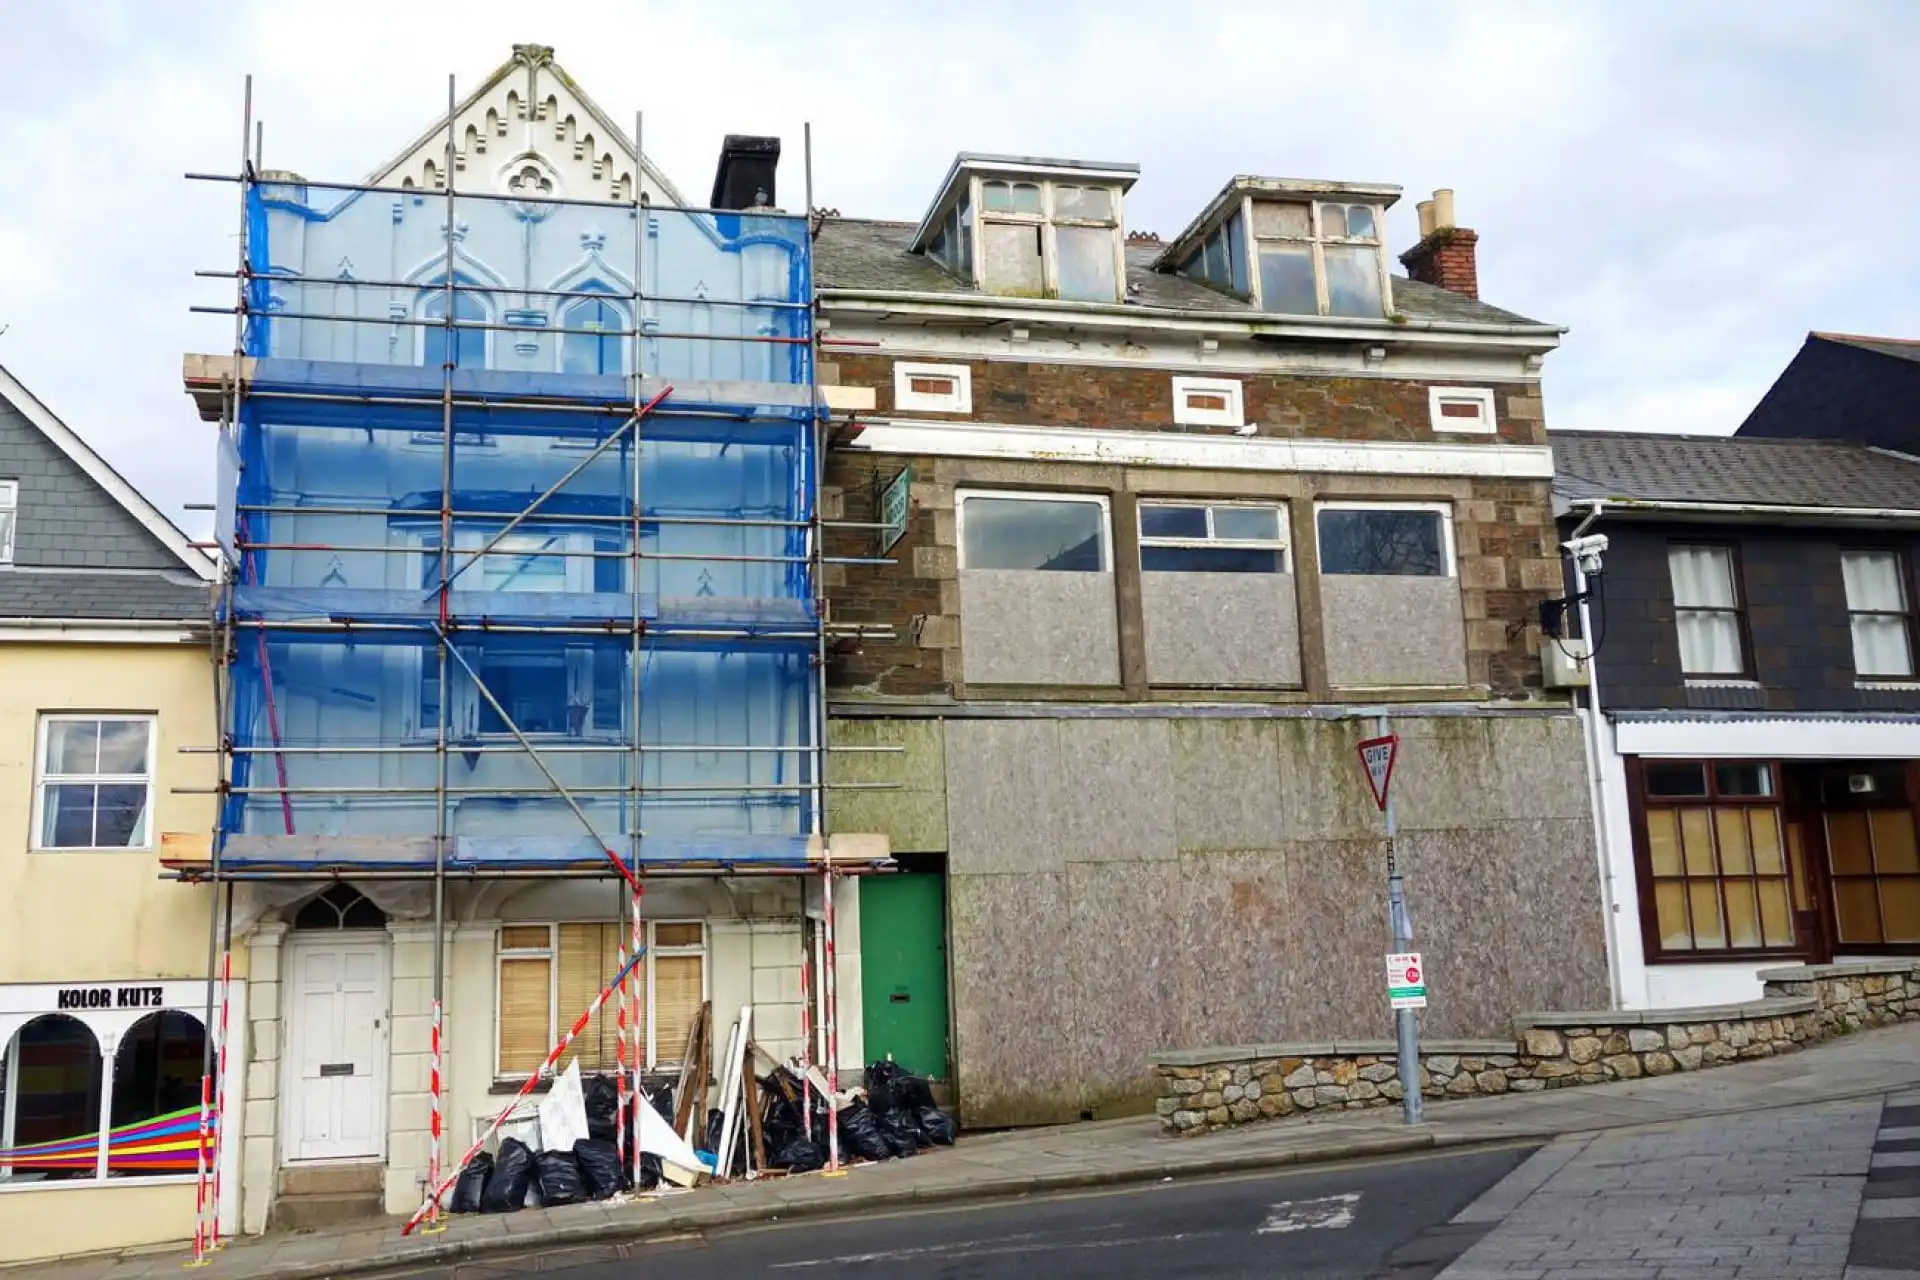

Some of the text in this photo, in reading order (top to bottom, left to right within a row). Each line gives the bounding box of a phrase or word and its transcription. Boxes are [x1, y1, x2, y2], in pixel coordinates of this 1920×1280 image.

[1366, 746, 1389, 763] GIVE
[58, 986, 163, 1009] KOLOR KUTZ
